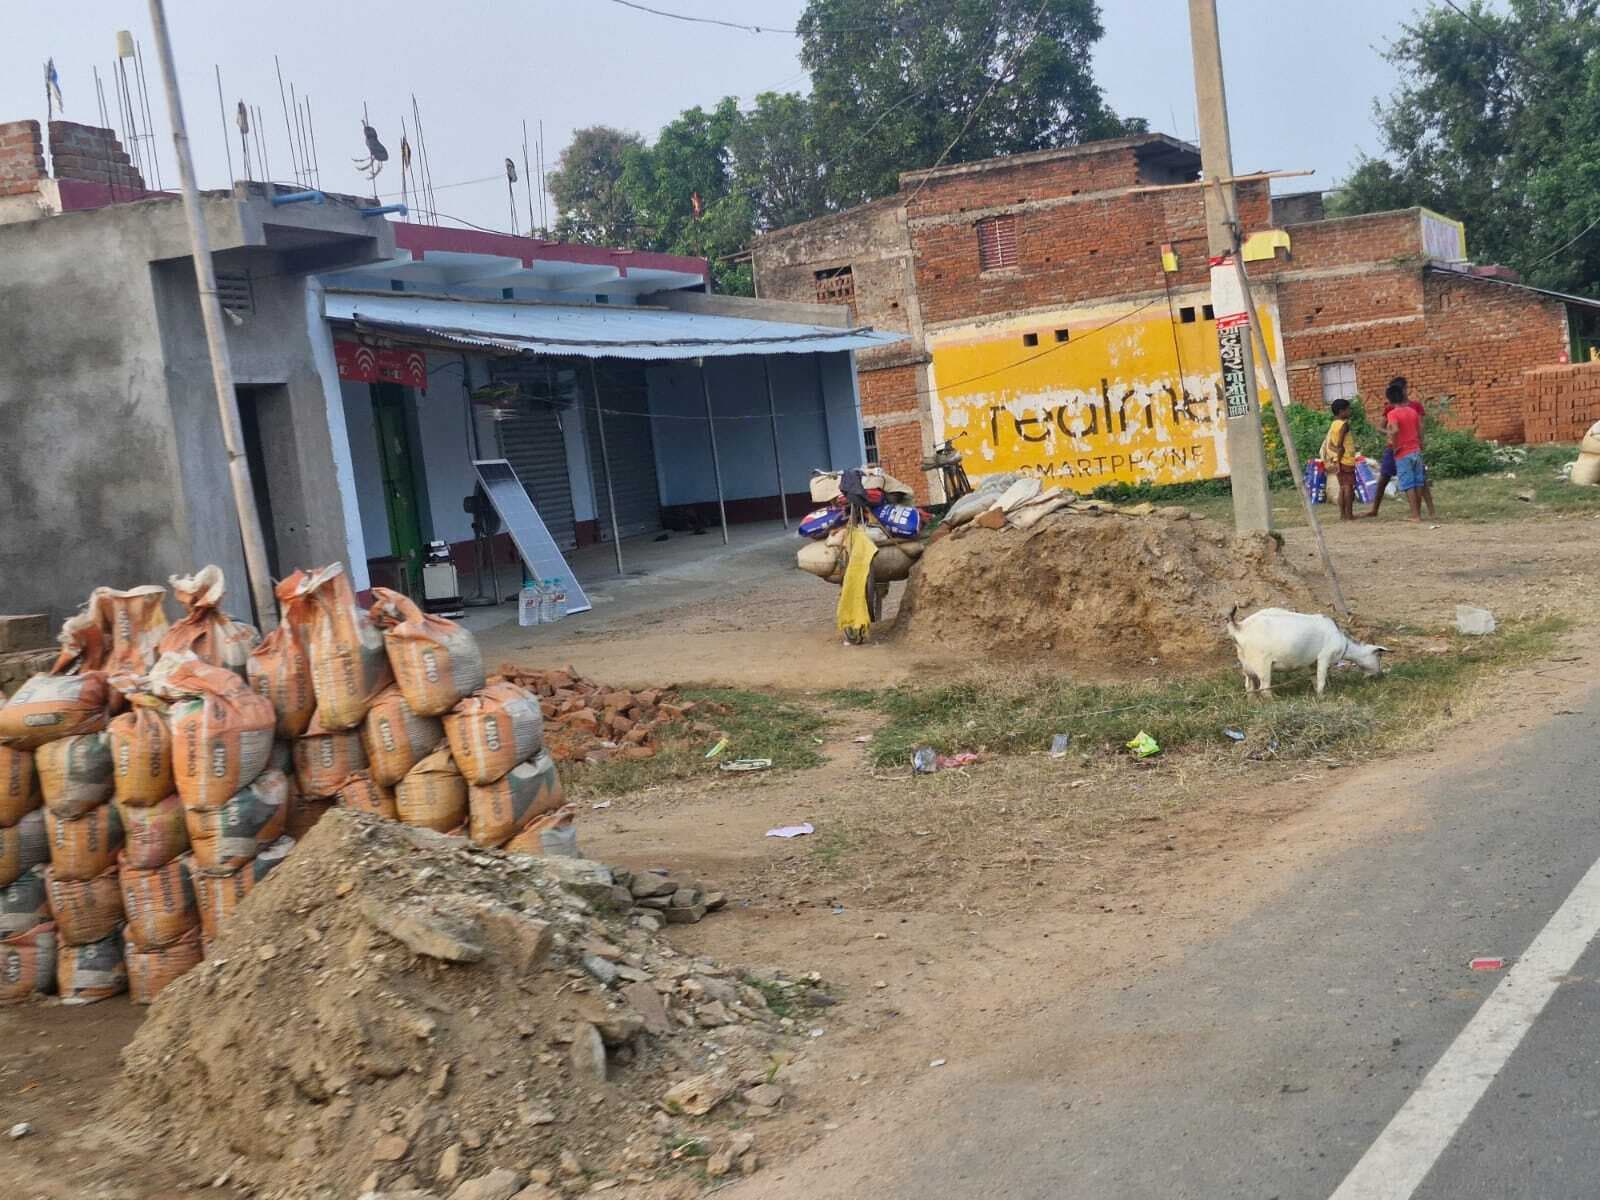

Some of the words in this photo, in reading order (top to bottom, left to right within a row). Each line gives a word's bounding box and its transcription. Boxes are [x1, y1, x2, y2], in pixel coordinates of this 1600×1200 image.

[423, 653, 439, 683] UNO
[379, 720, 395, 753] UNO
[484, 719, 500, 751] UNO
[119, 744, 130, 776] UNO
[212, 747, 226, 778] UNO
[320, 738, 334, 769] UNO
